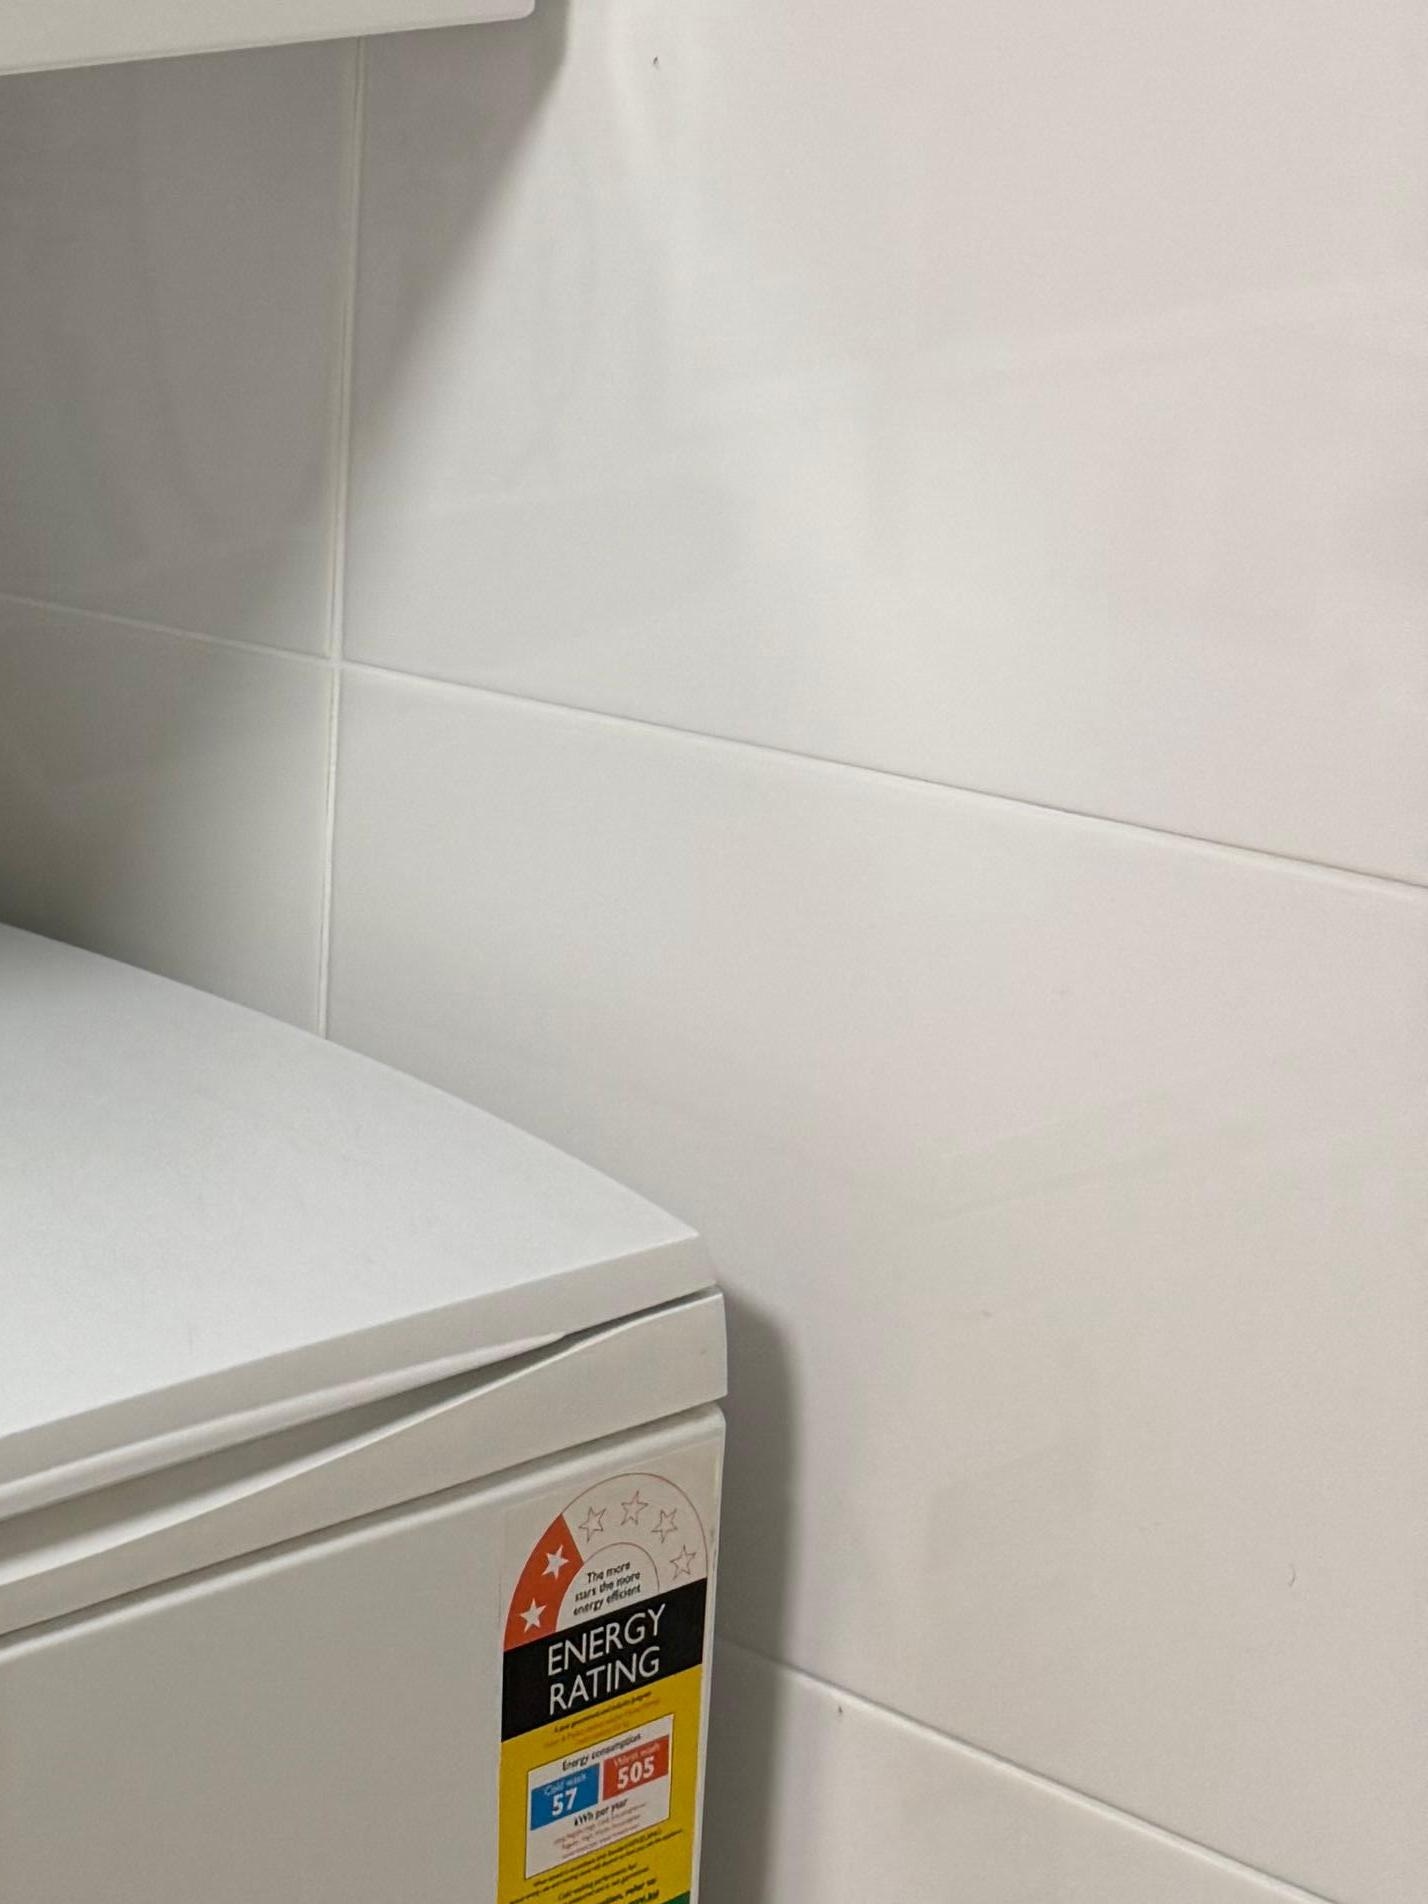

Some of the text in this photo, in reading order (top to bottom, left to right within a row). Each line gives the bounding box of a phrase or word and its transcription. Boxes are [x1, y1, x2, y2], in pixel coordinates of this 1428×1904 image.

[575, 1572, 641, 1602] stars the more
[587, 1562, 631, 1583] The more
[573, 1585, 641, 1616] energy efficient
[548, 1603, 666, 1676] ENERGY
[550, 1646, 660, 1715] RATING
[562, 1733, 642, 1771] Energy consumption
[616, 1756, 655, 1790] 505
[551, 1787, 578, 1816] 57
[574, 1799, 628, 1826] kWh per year
